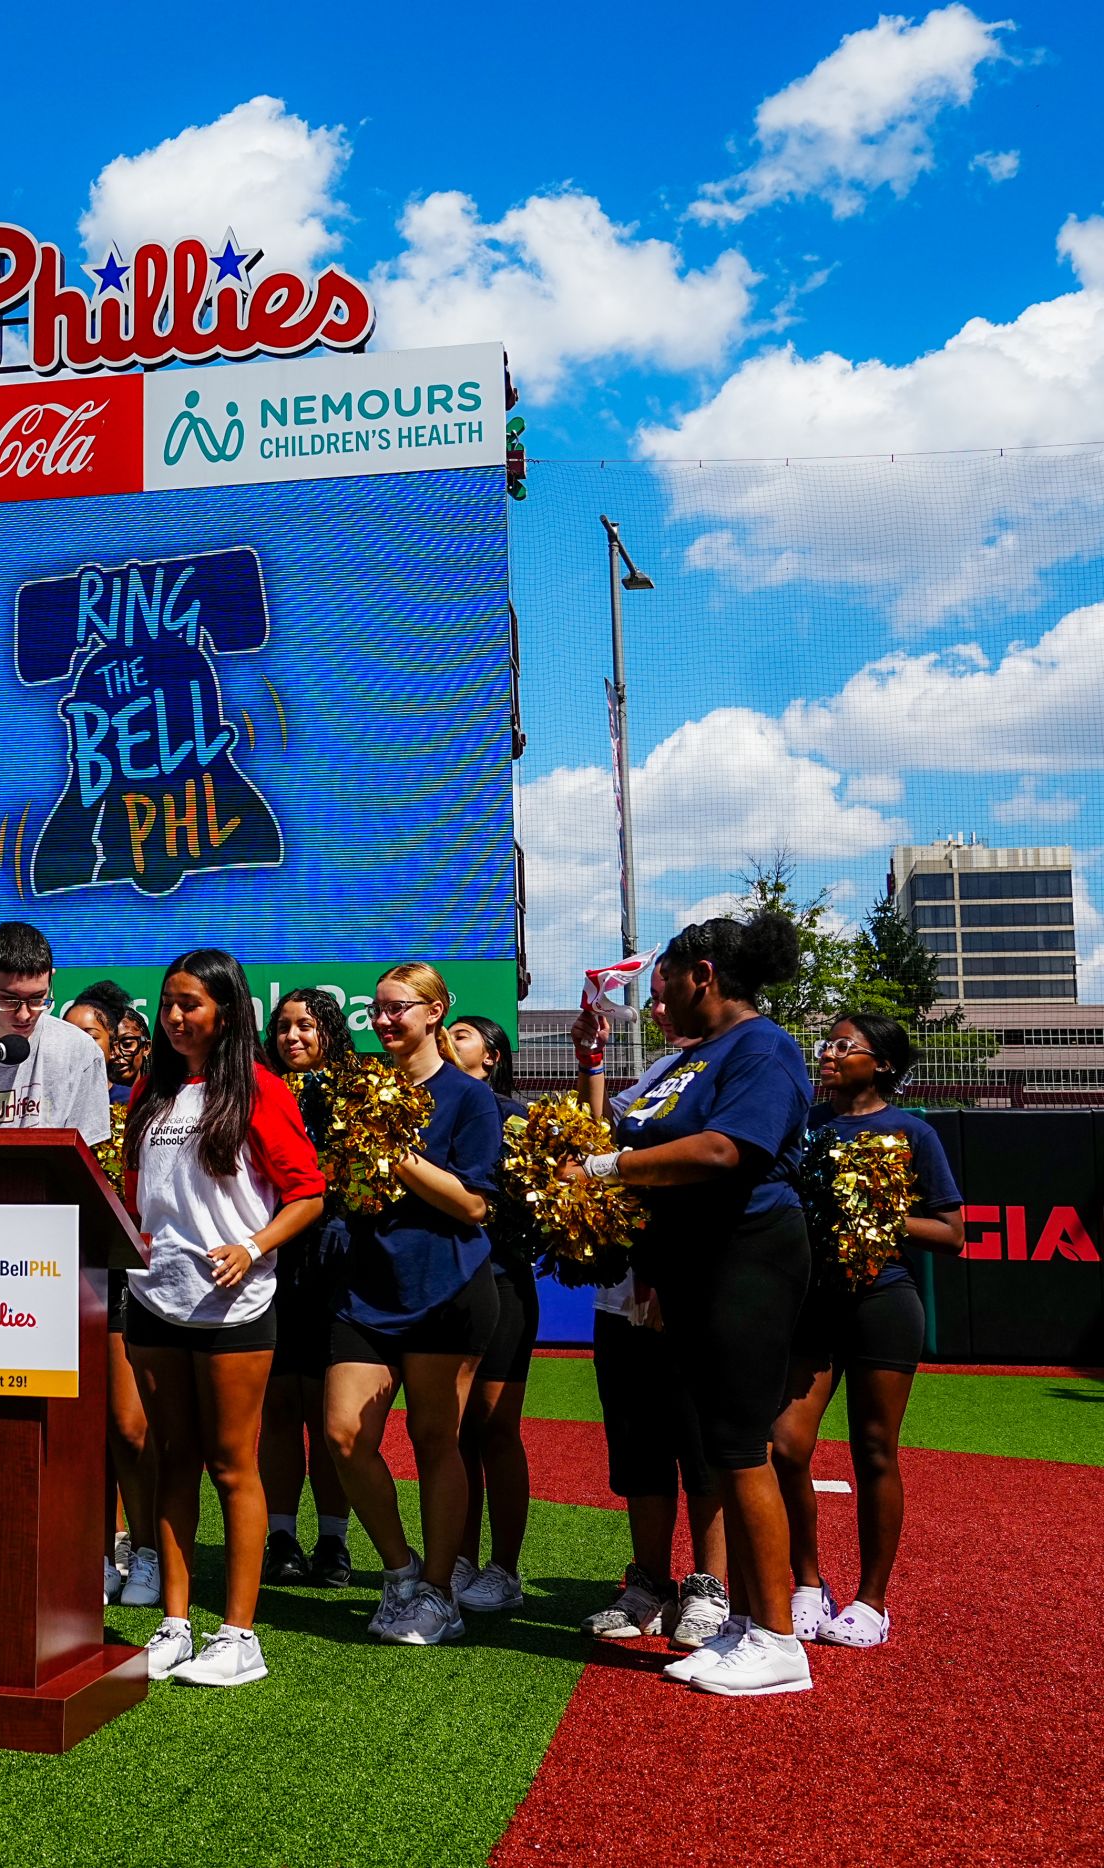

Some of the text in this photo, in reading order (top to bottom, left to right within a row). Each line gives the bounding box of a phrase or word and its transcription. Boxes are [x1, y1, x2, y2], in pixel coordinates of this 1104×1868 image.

[260, 381, 482, 428] NEMOURS
[259, 420, 483, 460] CHILDREN'S HEALTH
[76, 566, 201, 646] RING
[95, 656, 148, 698] THE
[65, 680, 230, 807] BELL
[122, 772, 241, 873] PHL
[150, 1125, 184, 1136] Unified
[150, 1135, 185, 1147] Schools
[8, 1375, 27, 1387] 29!
